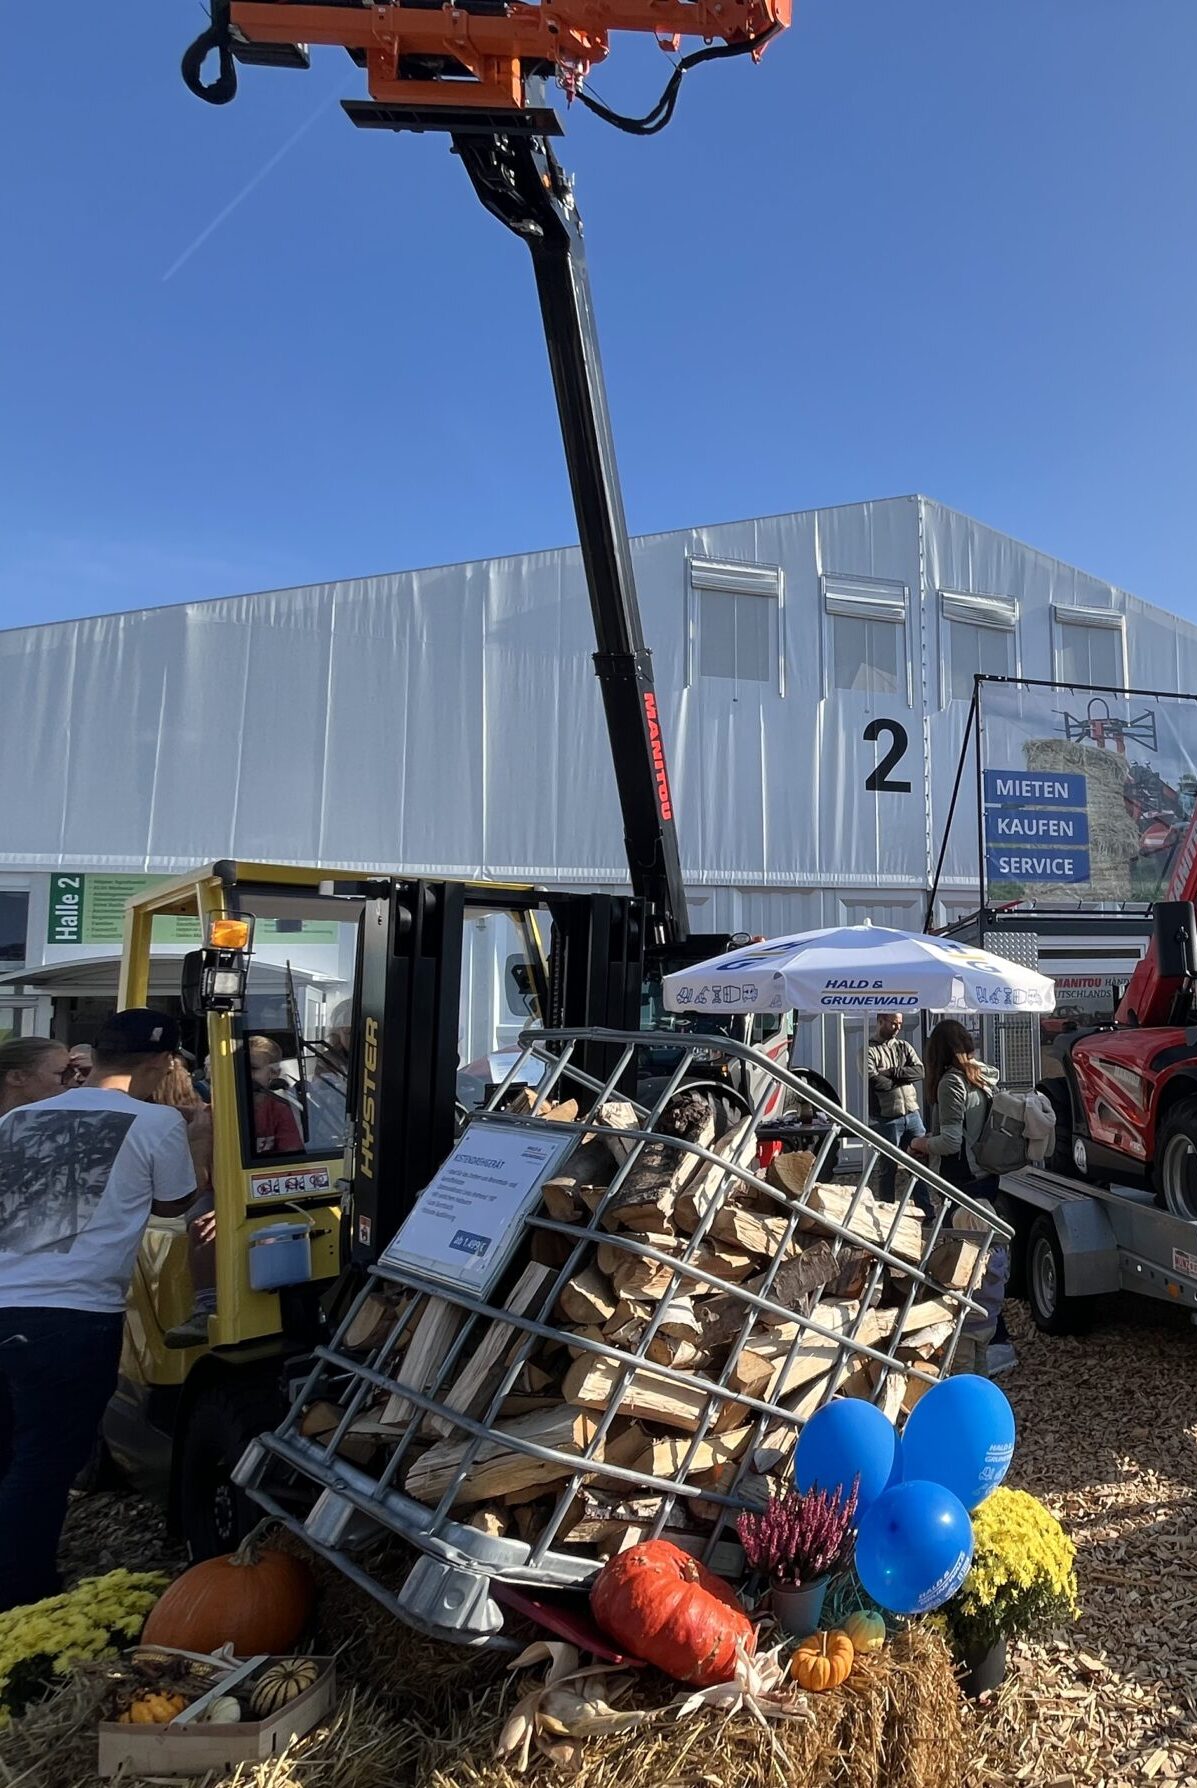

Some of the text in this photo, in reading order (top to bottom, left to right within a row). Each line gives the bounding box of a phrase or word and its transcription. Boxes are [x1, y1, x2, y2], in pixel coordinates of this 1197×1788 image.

[643, 692, 672, 820] MANITOU
[863, 718, 911, 793] 2
[996, 779, 1069, 798] MIETEN
[997, 818, 1074, 837] KAUFEN
[999, 857, 1074, 875] SERVICE
[55, 876, 80, 940] Halle 2
[825, 979, 883, 989] HALD &
[1055, 978, 1102, 988] MANITOU
[820, 995, 919, 1006] GRUNEWALD
[361, 1016, 379, 1179] HYSTER
